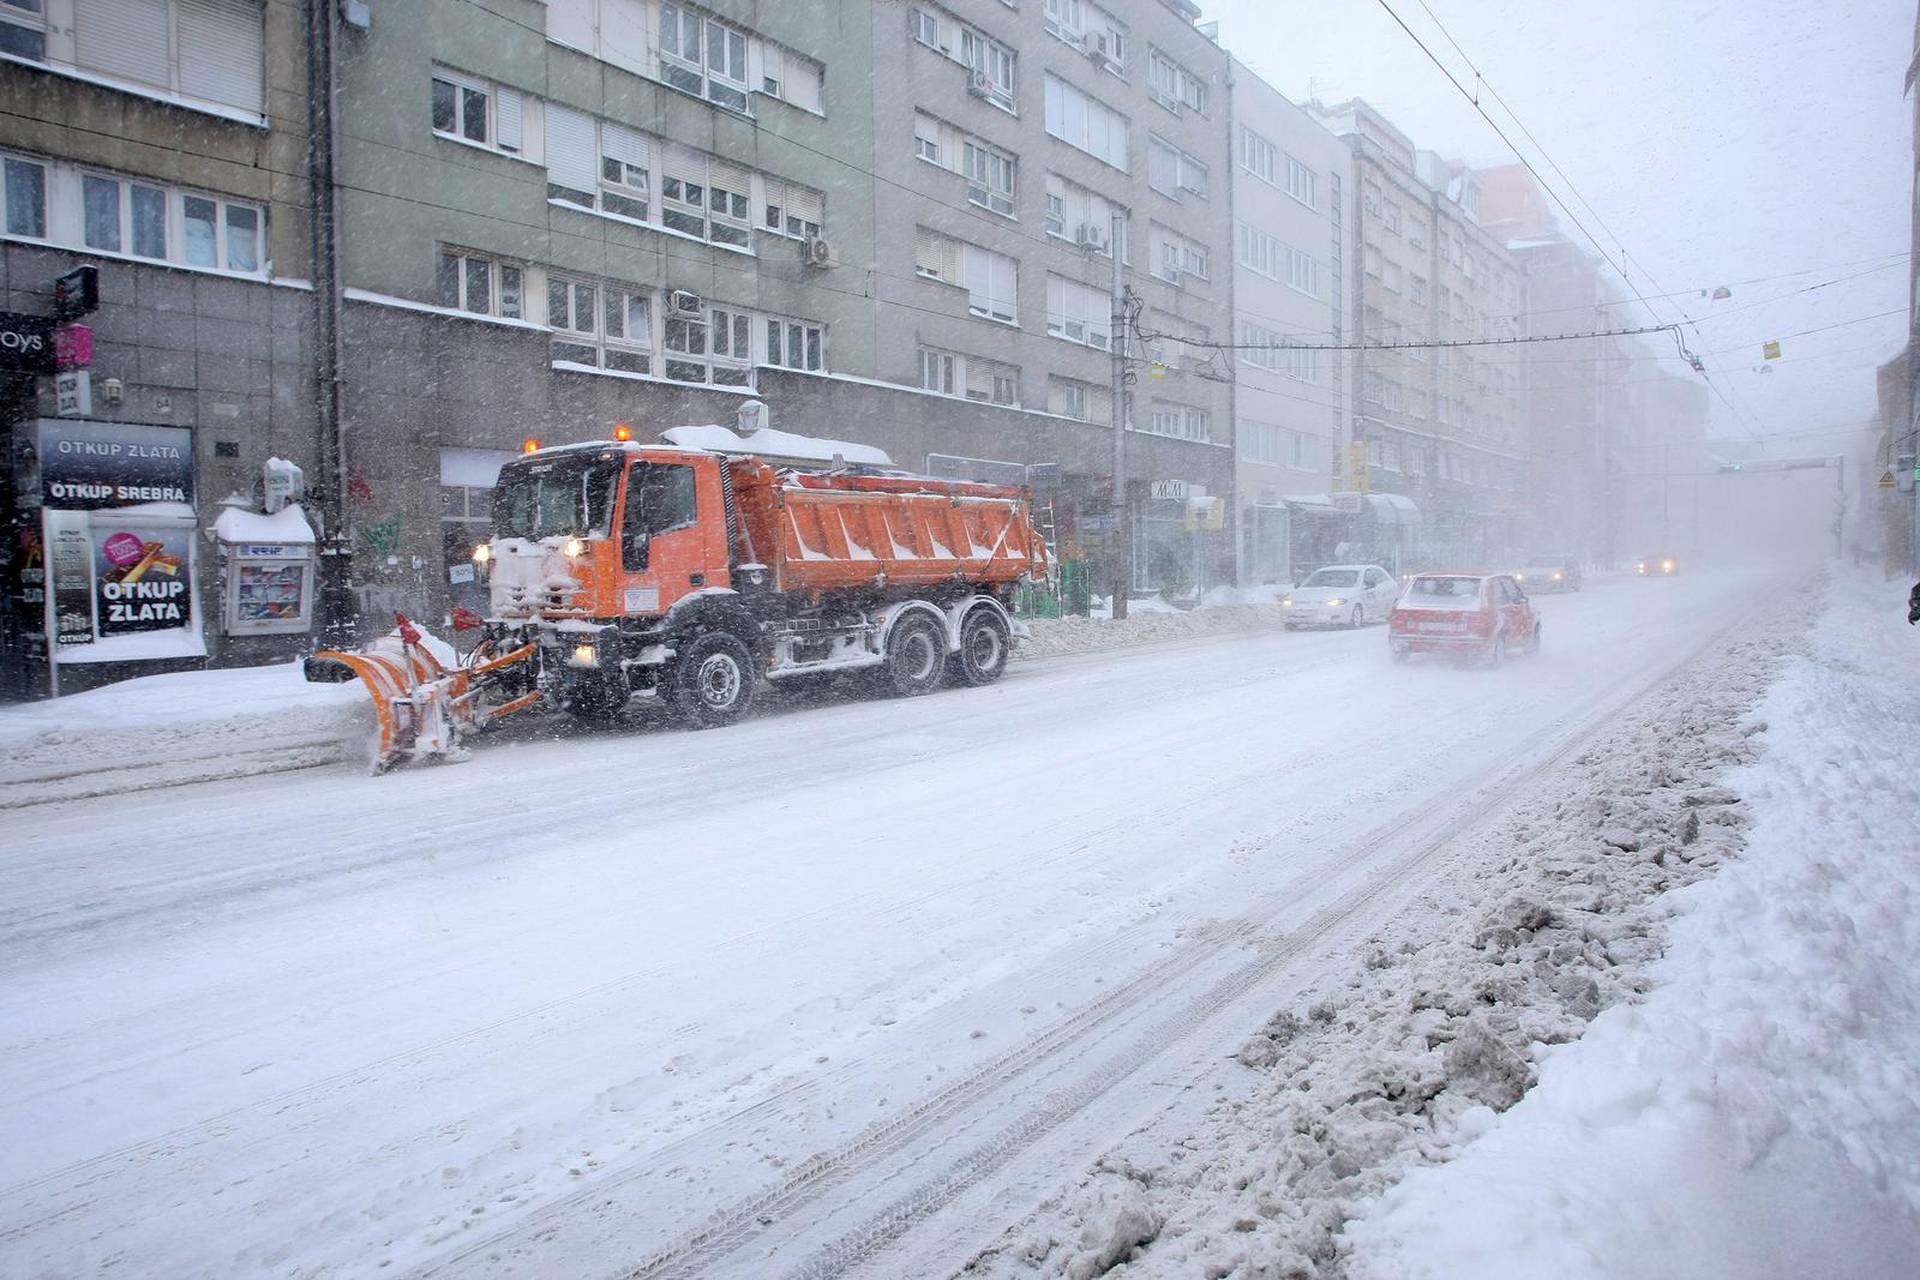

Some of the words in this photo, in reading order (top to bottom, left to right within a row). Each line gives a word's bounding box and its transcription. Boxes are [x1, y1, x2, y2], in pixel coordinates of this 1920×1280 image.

[59, 441, 121, 455] OTKUP
[128, 445, 180, 459] ZLATA
[51, 484, 112, 498] OTKUP
[117, 486, 185, 501] SREBRA
[103, 581, 184, 600] OTKUP
[109, 603, 180, 622] ZLATA
[60, 634, 92, 642] OTKUP
